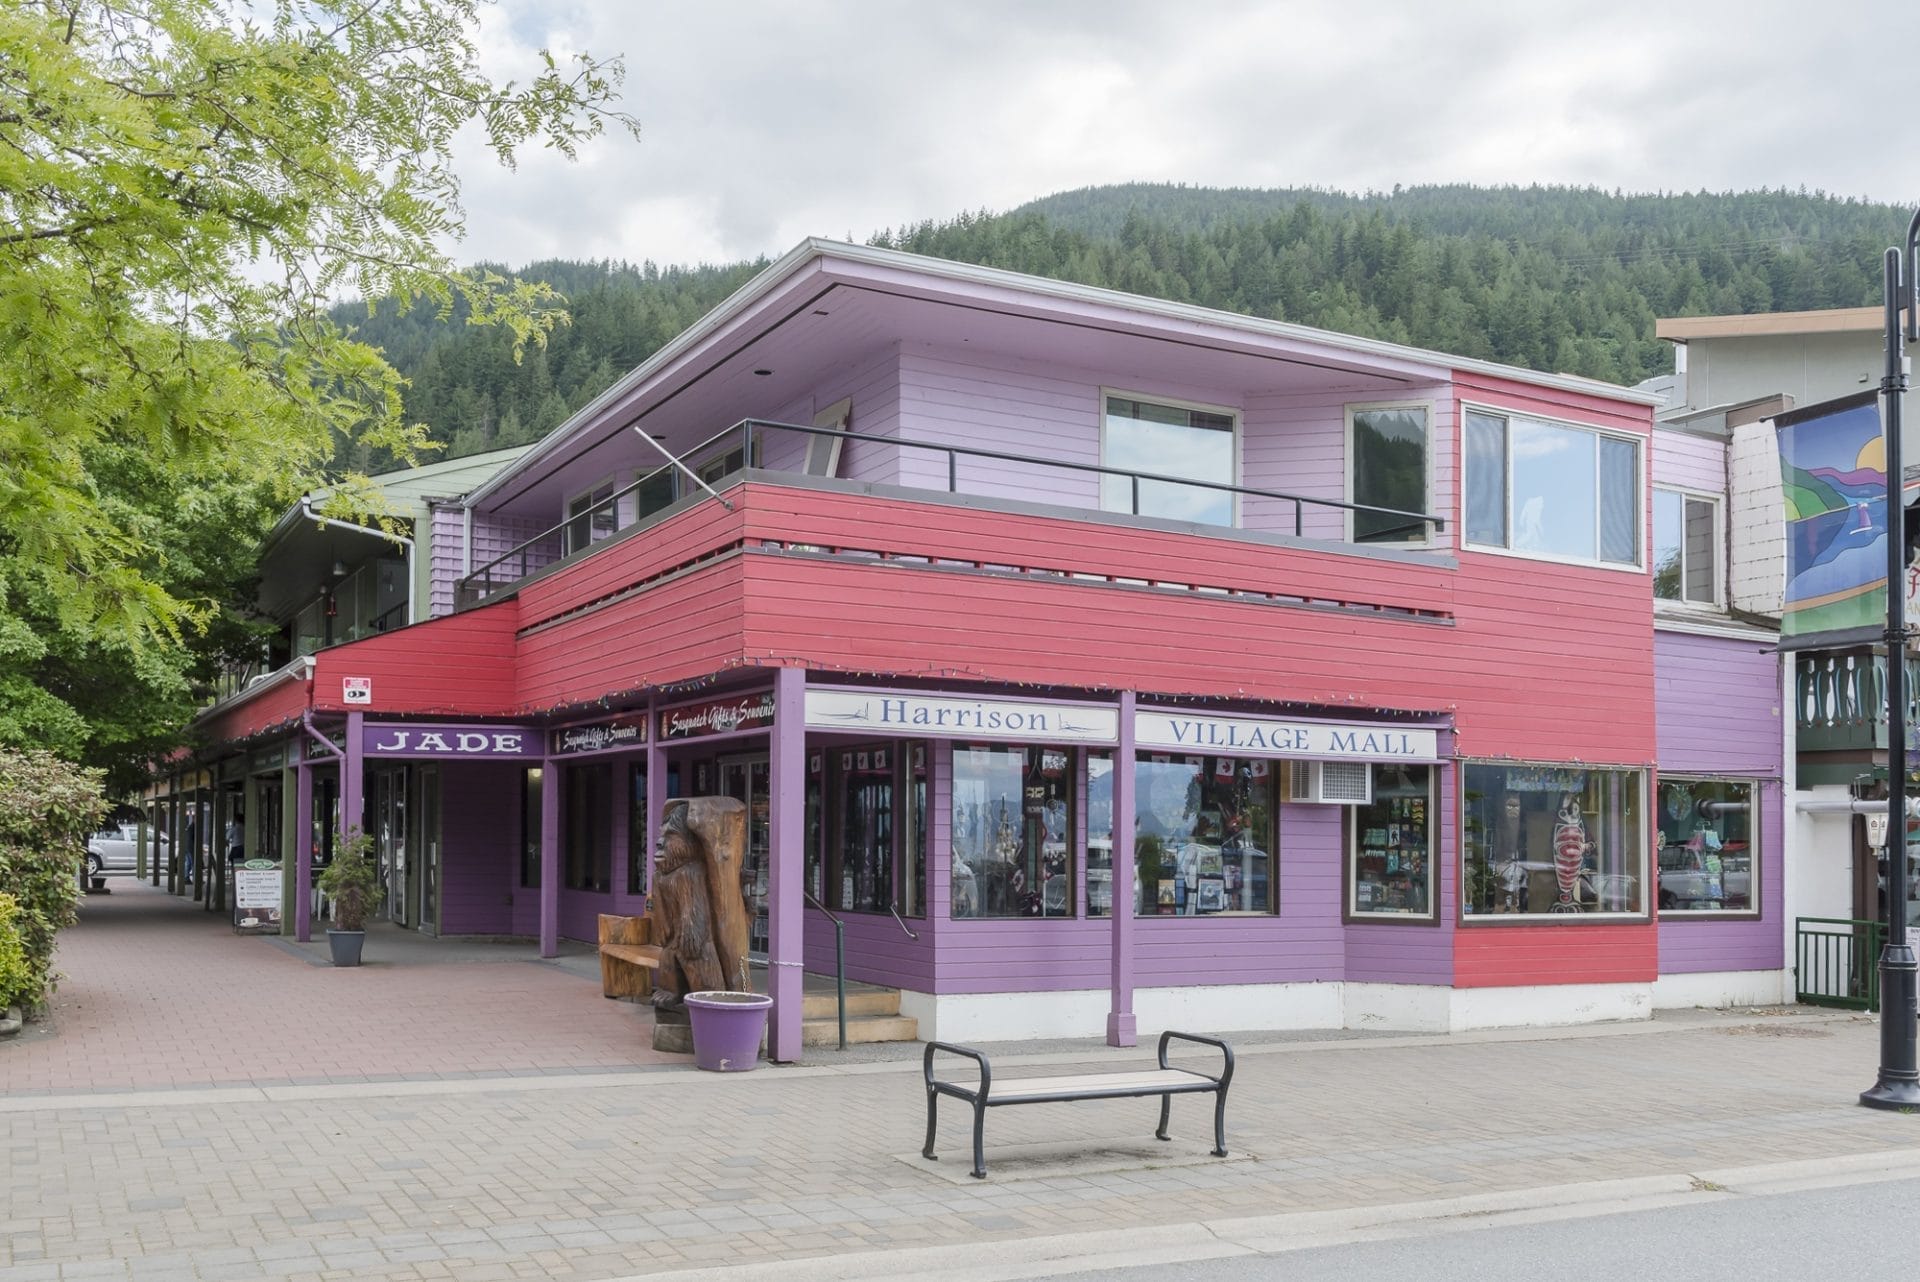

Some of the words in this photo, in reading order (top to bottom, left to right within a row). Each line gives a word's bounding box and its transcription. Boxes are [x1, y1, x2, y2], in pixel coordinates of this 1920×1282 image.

[670, 707, 707, 737] Sasquatch
[708, 705, 729, 731] Gifts
[730, 707, 737, 721] &
[880, 699, 1048, 731] Harrison
[376, 731, 522, 753] JADE
[1169, 719, 1310, 750] VILLAGE
[1328, 731, 1416, 755] MALL
